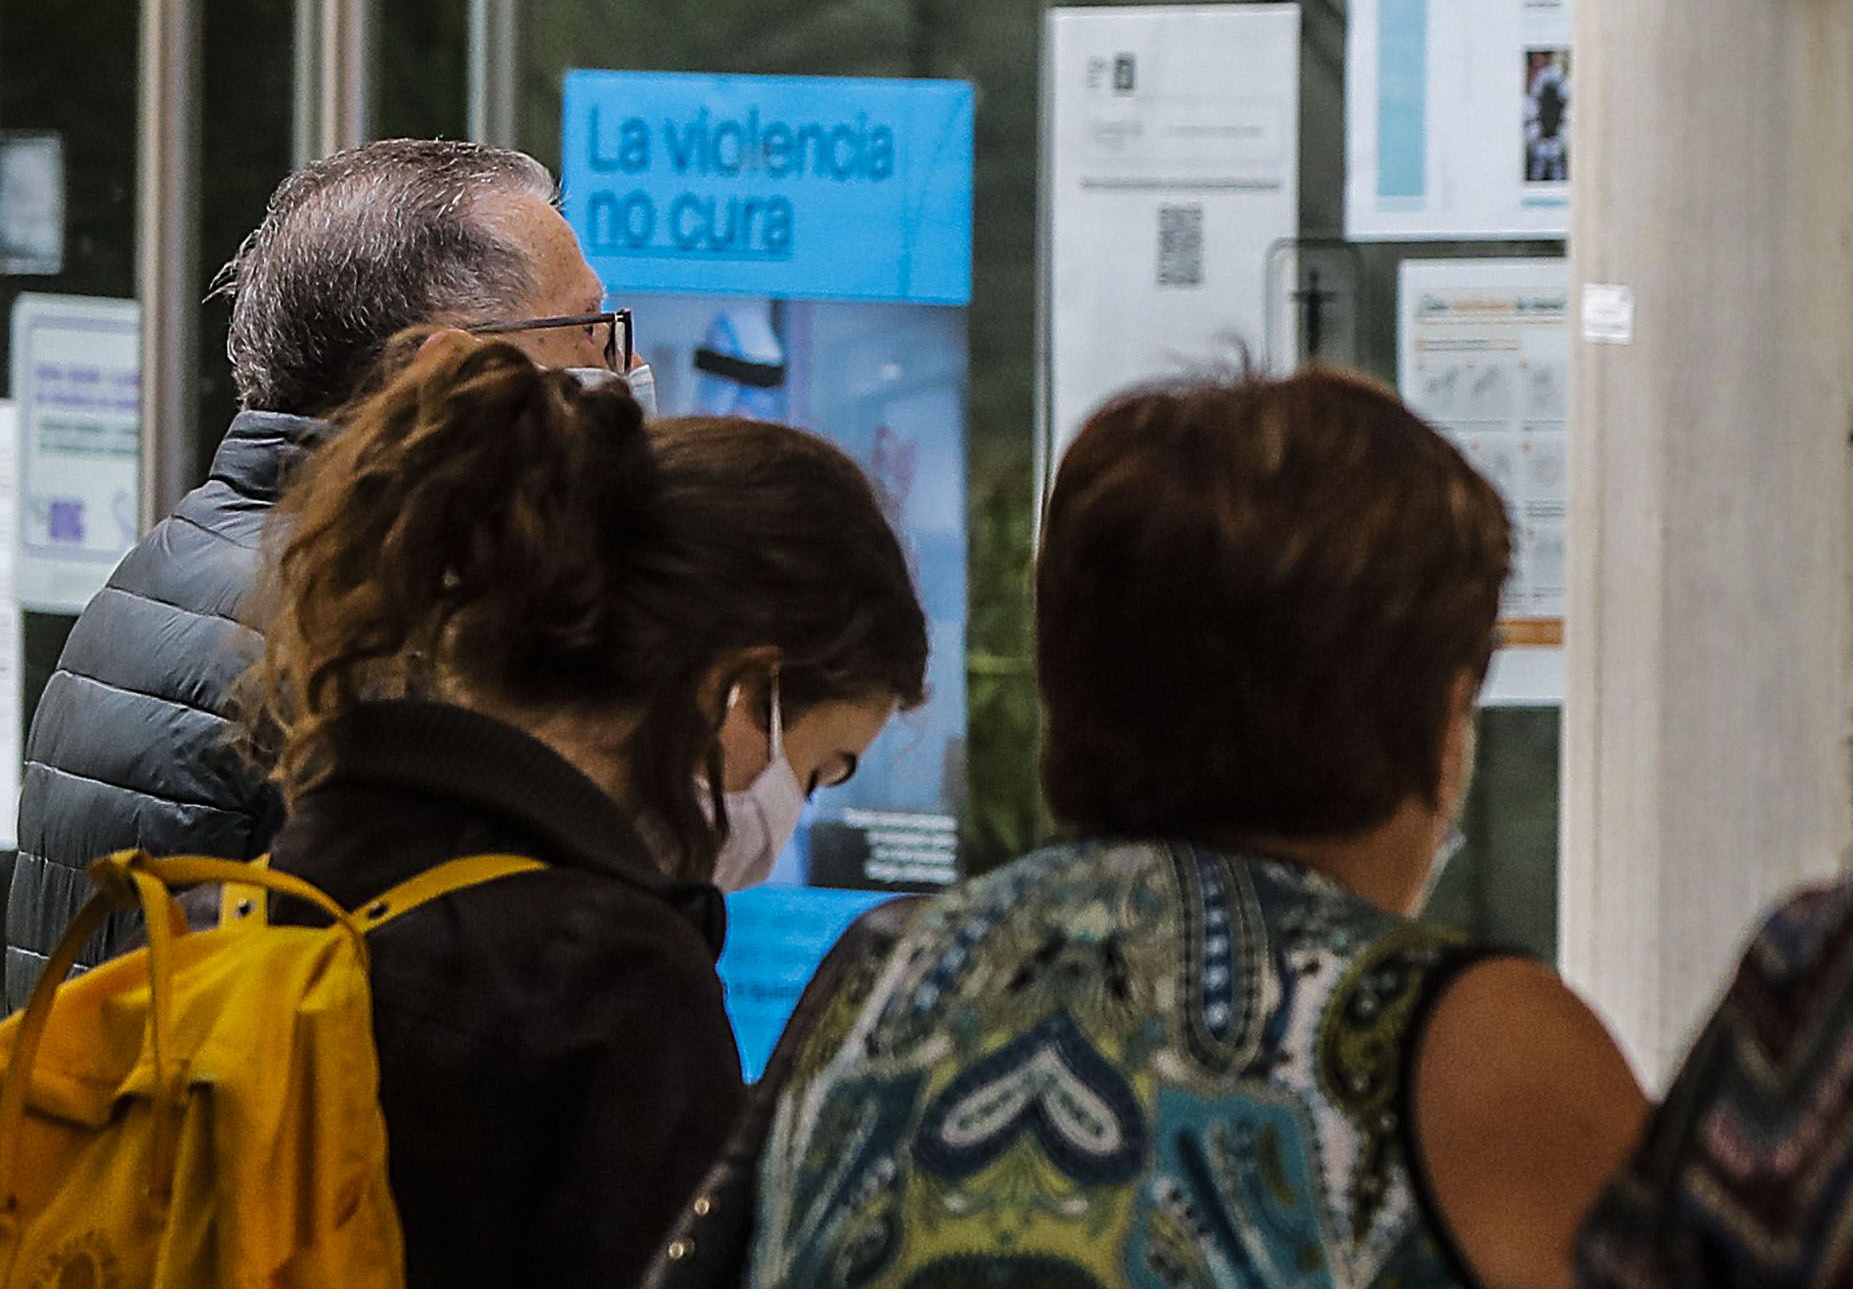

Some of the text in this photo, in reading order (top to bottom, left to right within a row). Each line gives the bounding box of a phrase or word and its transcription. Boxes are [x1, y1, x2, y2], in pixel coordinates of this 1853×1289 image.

[587, 104, 895, 183] La violencia
[587, 189, 794, 254] no cura
